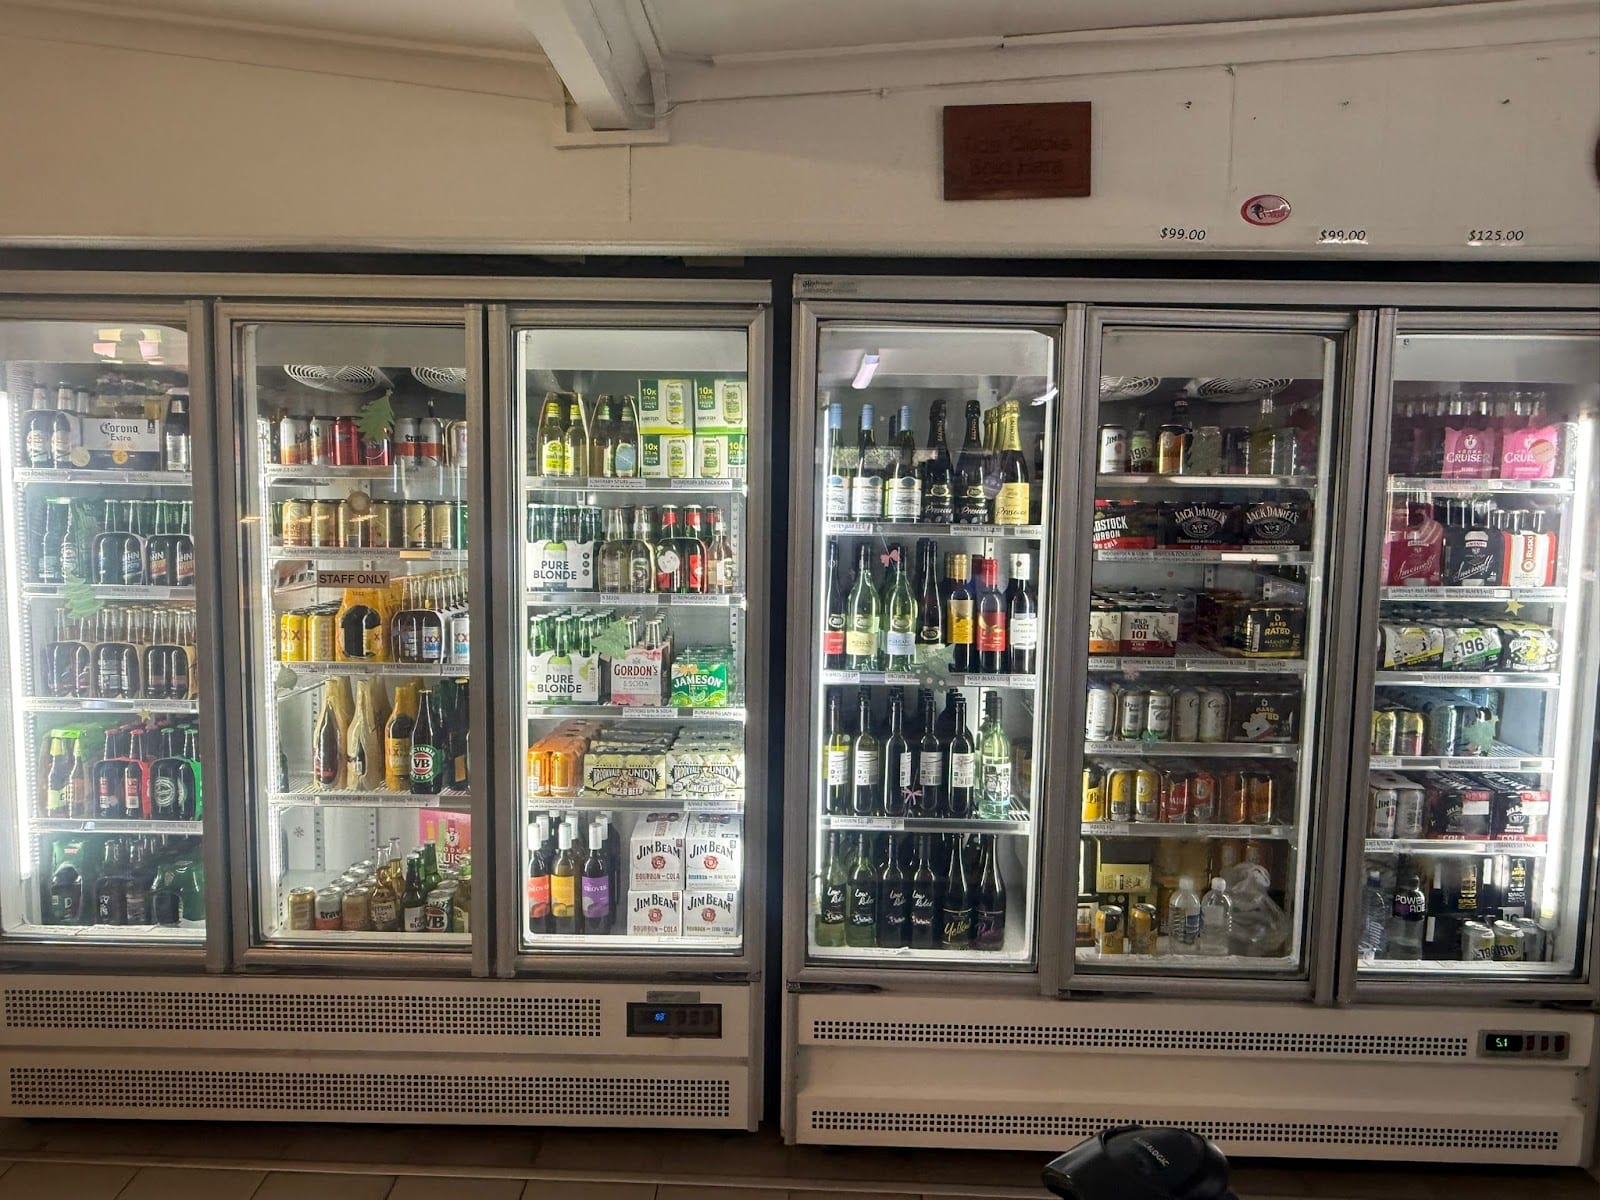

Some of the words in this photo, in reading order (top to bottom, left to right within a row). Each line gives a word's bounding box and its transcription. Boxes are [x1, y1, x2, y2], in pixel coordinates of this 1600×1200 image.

[1160, 227, 1206, 242] $99.00
[1318, 229, 1366, 242] $99.00
[1468, 229, 1524, 242] $125.00
[100, 422, 140, 436] Corona
[1246, 507, 1267, 525] JACK
[541, 560, 569, 570] PURE
[319, 574, 355, 585] STAFF
[357, 574, 388, 585] ONLY
[533, 570, 577, 580] BLONDE
[1131, 630, 1147, 639] 101
[1264, 628, 1291, 636] RATED
[613, 664, 658, 676] GORDON'S
[545, 674, 574, 683] PURE
[674, 674, 723, 688] JAMESON
[537, 684, 582, 693] BLONDE
[413, 759, 430, 768] VB
[628, 768, 656, 786] UNION
[710, 766, 738, 783] UNION
[628, 787, 644, 796] BEER
[636, 844, 654, 860] JIM
[655, 840, 681, 860] BEAM
[689, 843, 707, 859] JIM
[708, 840, 734, 860] BEAM
[666, 872, 680, 880] COLA
[633, 896, 651, 913] JIM
[651, 893, 677, 913] BEAM
[687, 895, 705, 911] JIM
[706, 893, 731, 914] BEAM
[663, 925, 678, 933] COLA
